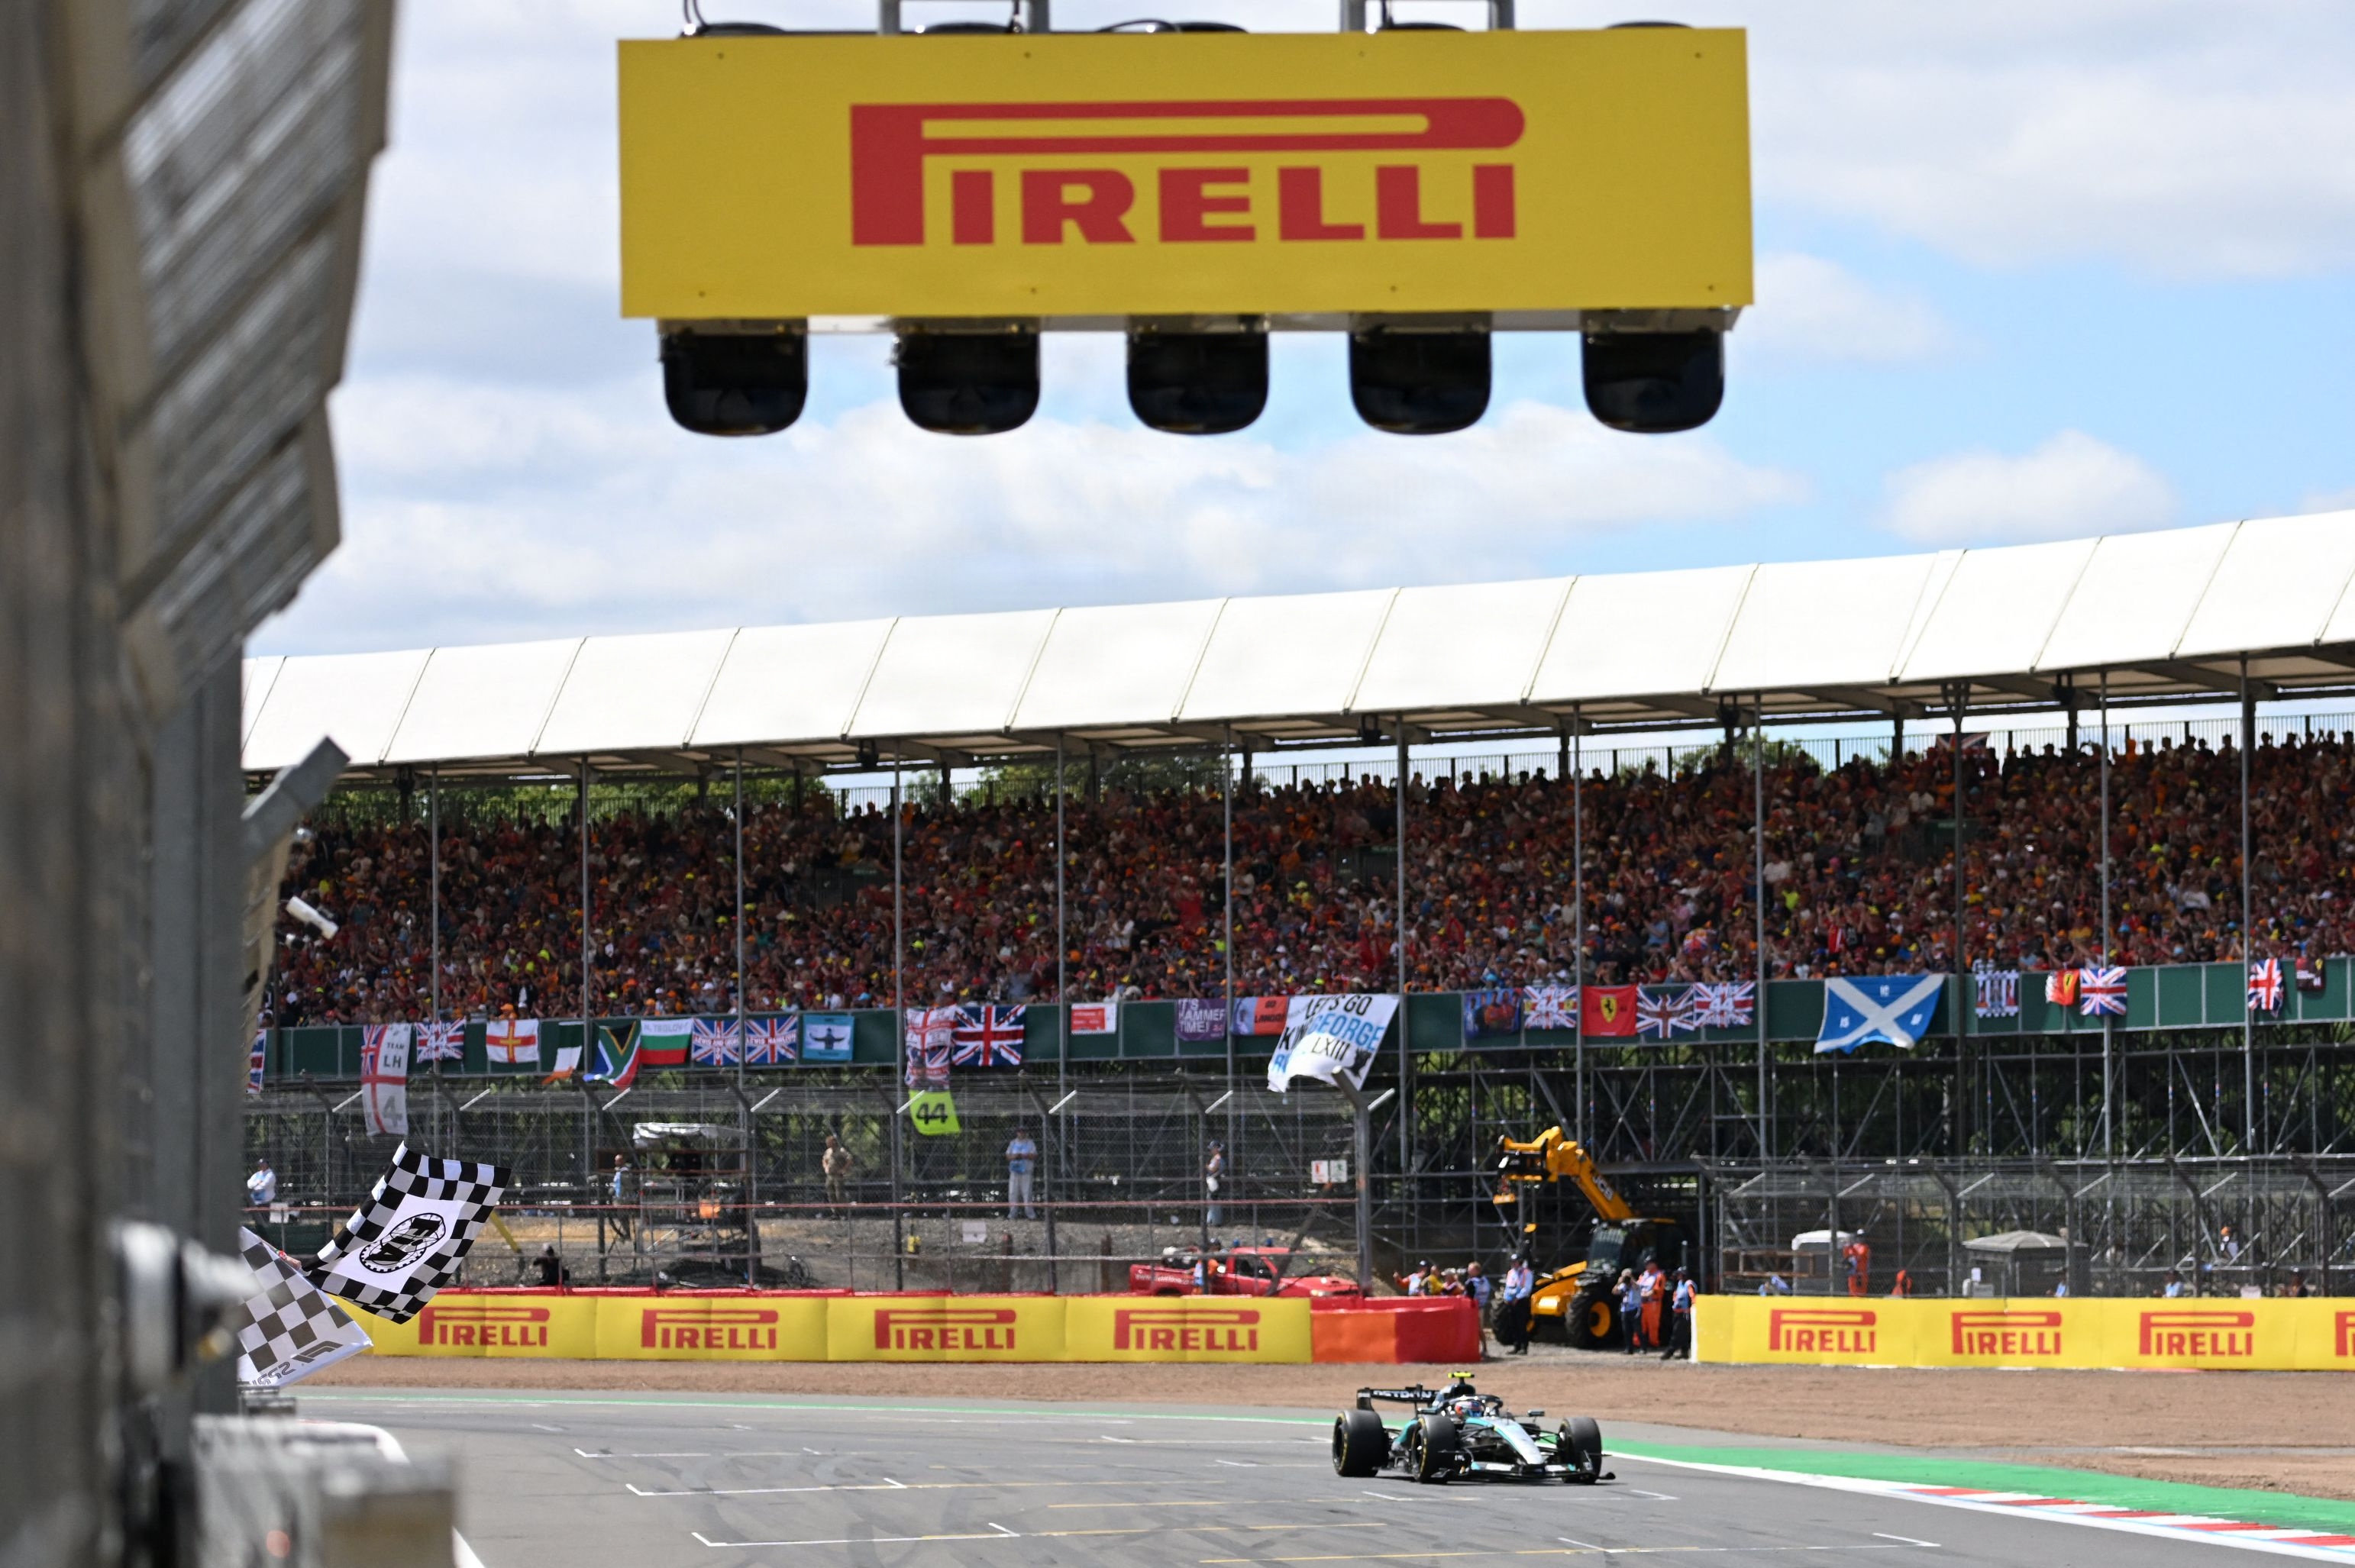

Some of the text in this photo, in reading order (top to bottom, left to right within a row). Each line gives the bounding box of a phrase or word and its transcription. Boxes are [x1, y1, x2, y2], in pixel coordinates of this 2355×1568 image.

[851, 97, 1526, 247] PIRELLI
[1344, 995, 1372, 1016] GO
[1308, 1013, 1385, 1051] GEORGE
[1311, 1037, 1350, 1060] LXIII
[383, 1055, 402, 1068] LH
[916, 1103, 948, 1124] 44
[418, 1306, 550, 1347] PIRELLI
[641, 1308, 778, 1349] PIRELLI
[874, 1308, 1016, 1350] PIRELLI
[1114, 1308, 1260, 1350] PIRELLI
[1769, 1309, 1876, 1352] PIRELLI
[1952, 1311, 2061, 1354] PIRELLI
[2139, 1312, 2254, 1356] PIRELLI
